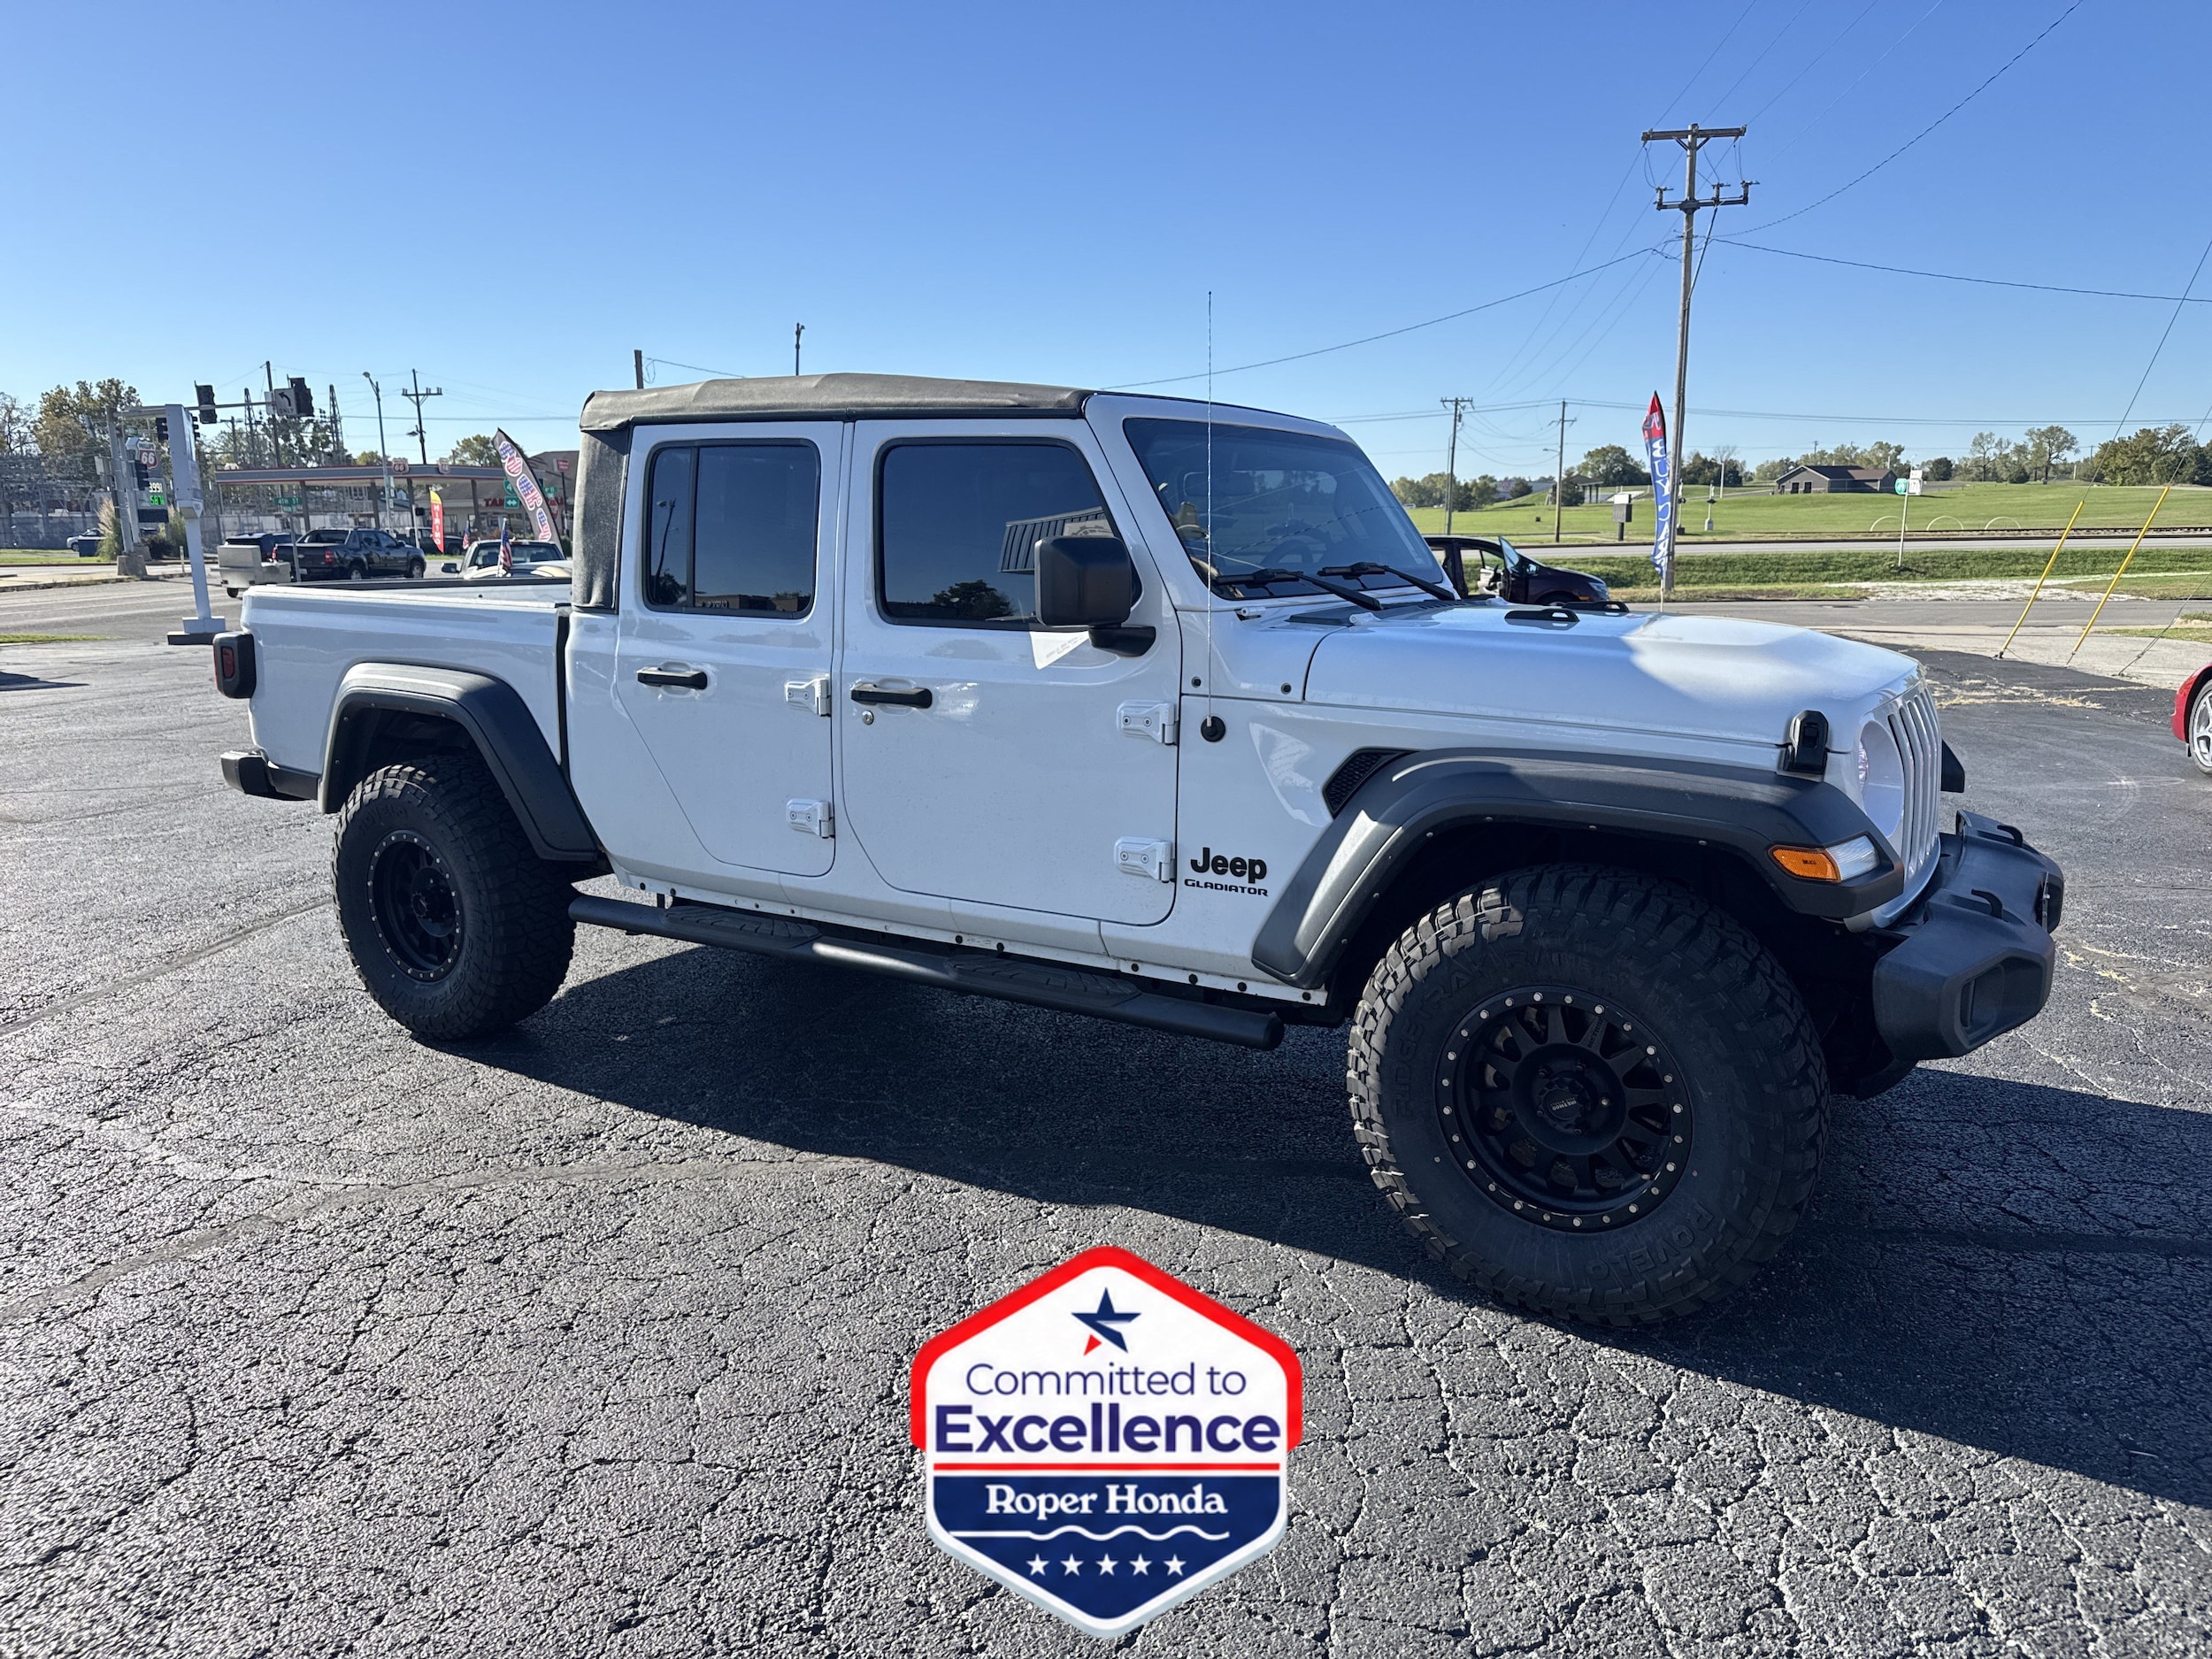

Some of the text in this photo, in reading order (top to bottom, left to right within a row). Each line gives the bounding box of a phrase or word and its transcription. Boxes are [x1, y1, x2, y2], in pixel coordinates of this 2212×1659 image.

[142, 451, 156, 465] 66
[1190, 847, 1267, 883] Jeep
[1184, 879, 1269, 897] GLADIATOR
[1585, 1202, 1715, 1281] ROVELO
